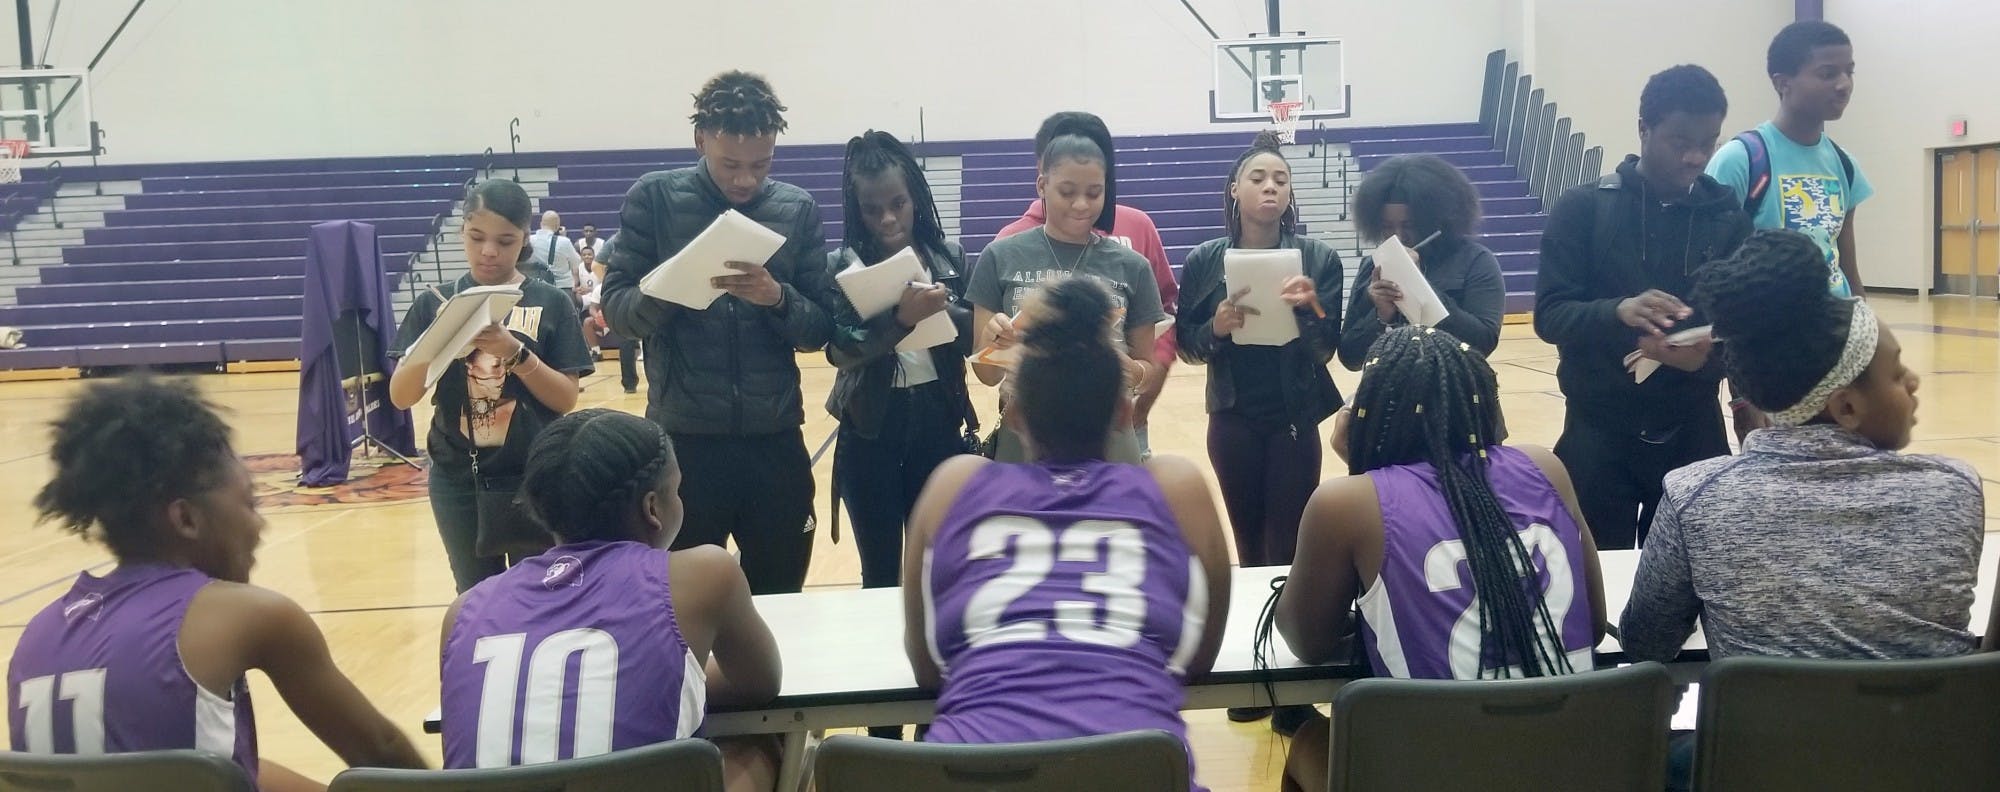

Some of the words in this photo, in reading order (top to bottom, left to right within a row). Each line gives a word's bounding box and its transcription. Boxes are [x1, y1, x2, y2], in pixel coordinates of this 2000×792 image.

[963, 514, 1148, 649] 23
[19, 667, 108, 754] 11
[472, 628, 620, 769] 10
